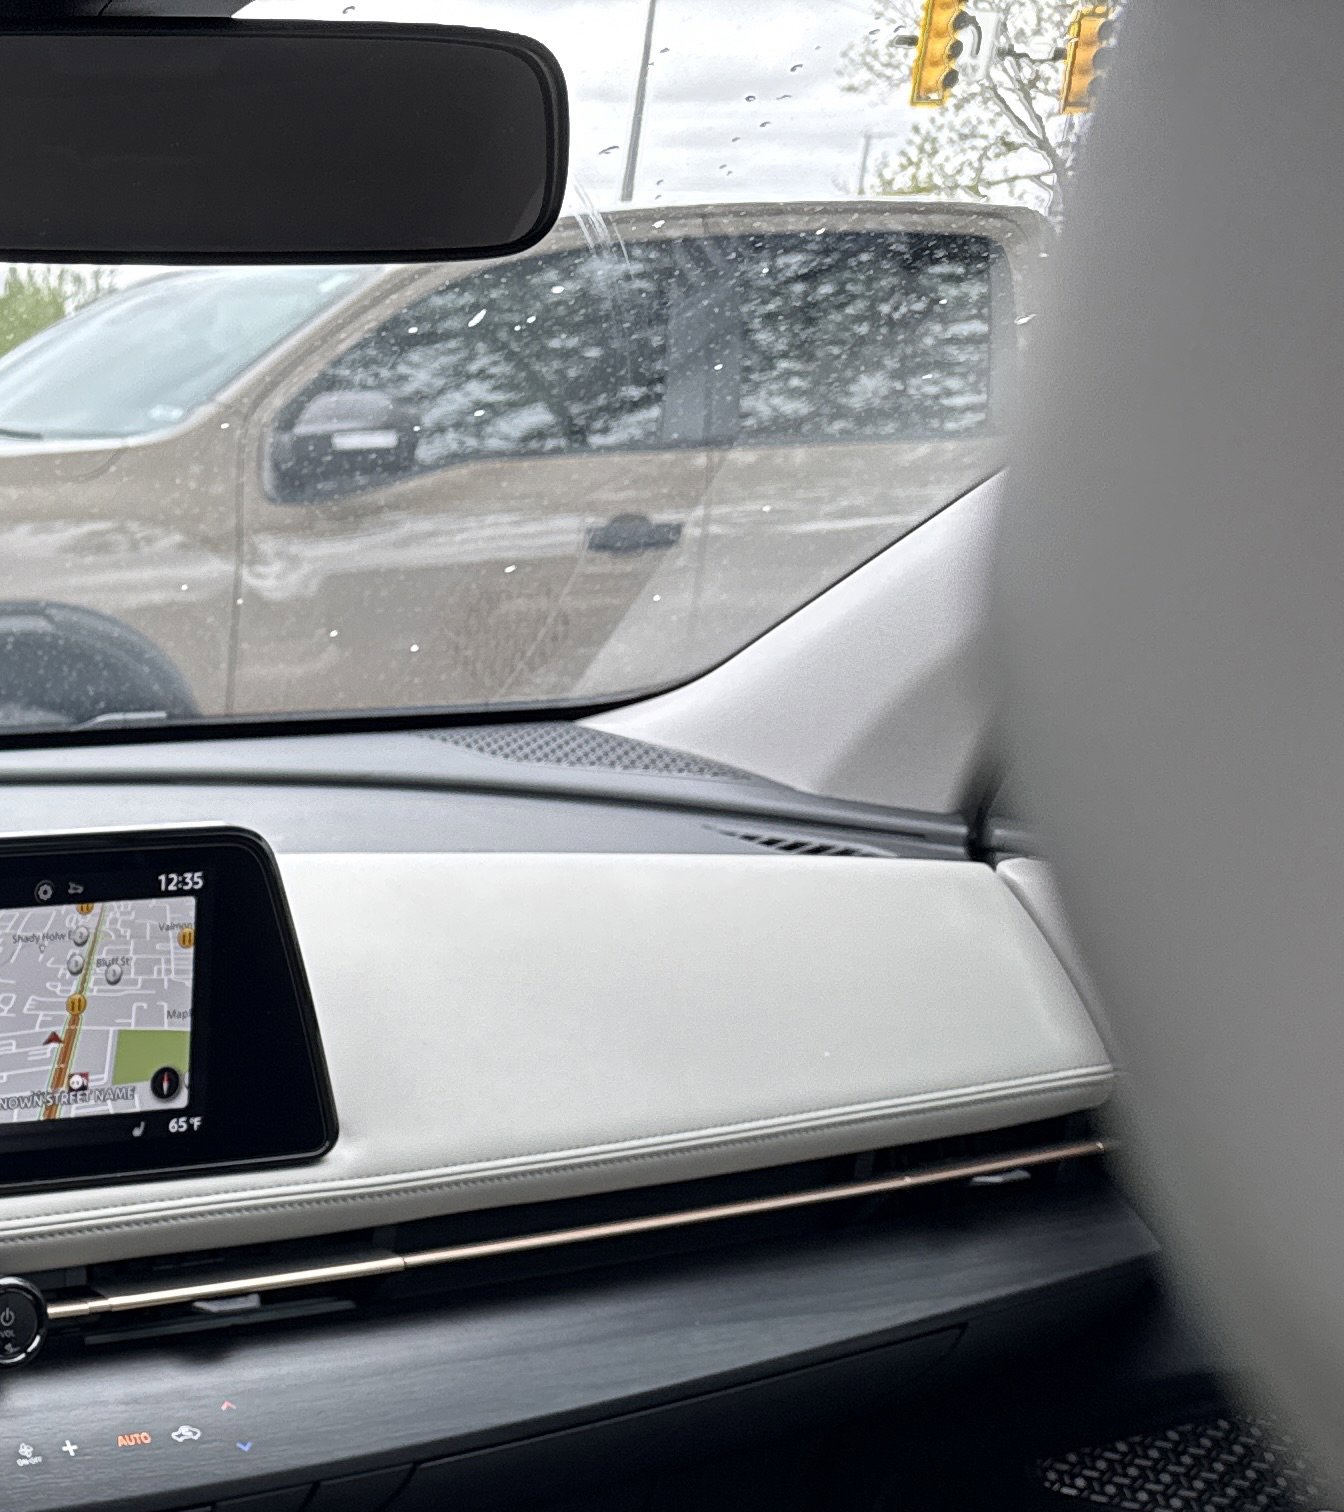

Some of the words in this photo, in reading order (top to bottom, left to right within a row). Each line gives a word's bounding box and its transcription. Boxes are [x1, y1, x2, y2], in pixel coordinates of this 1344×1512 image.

[157, 871, 204, 892] 12:35
[44, 1089, 92, 1107] STREET
[93, 1085, 136, 1102] NAME
[117, 1431, 152, 1448] AUTO
